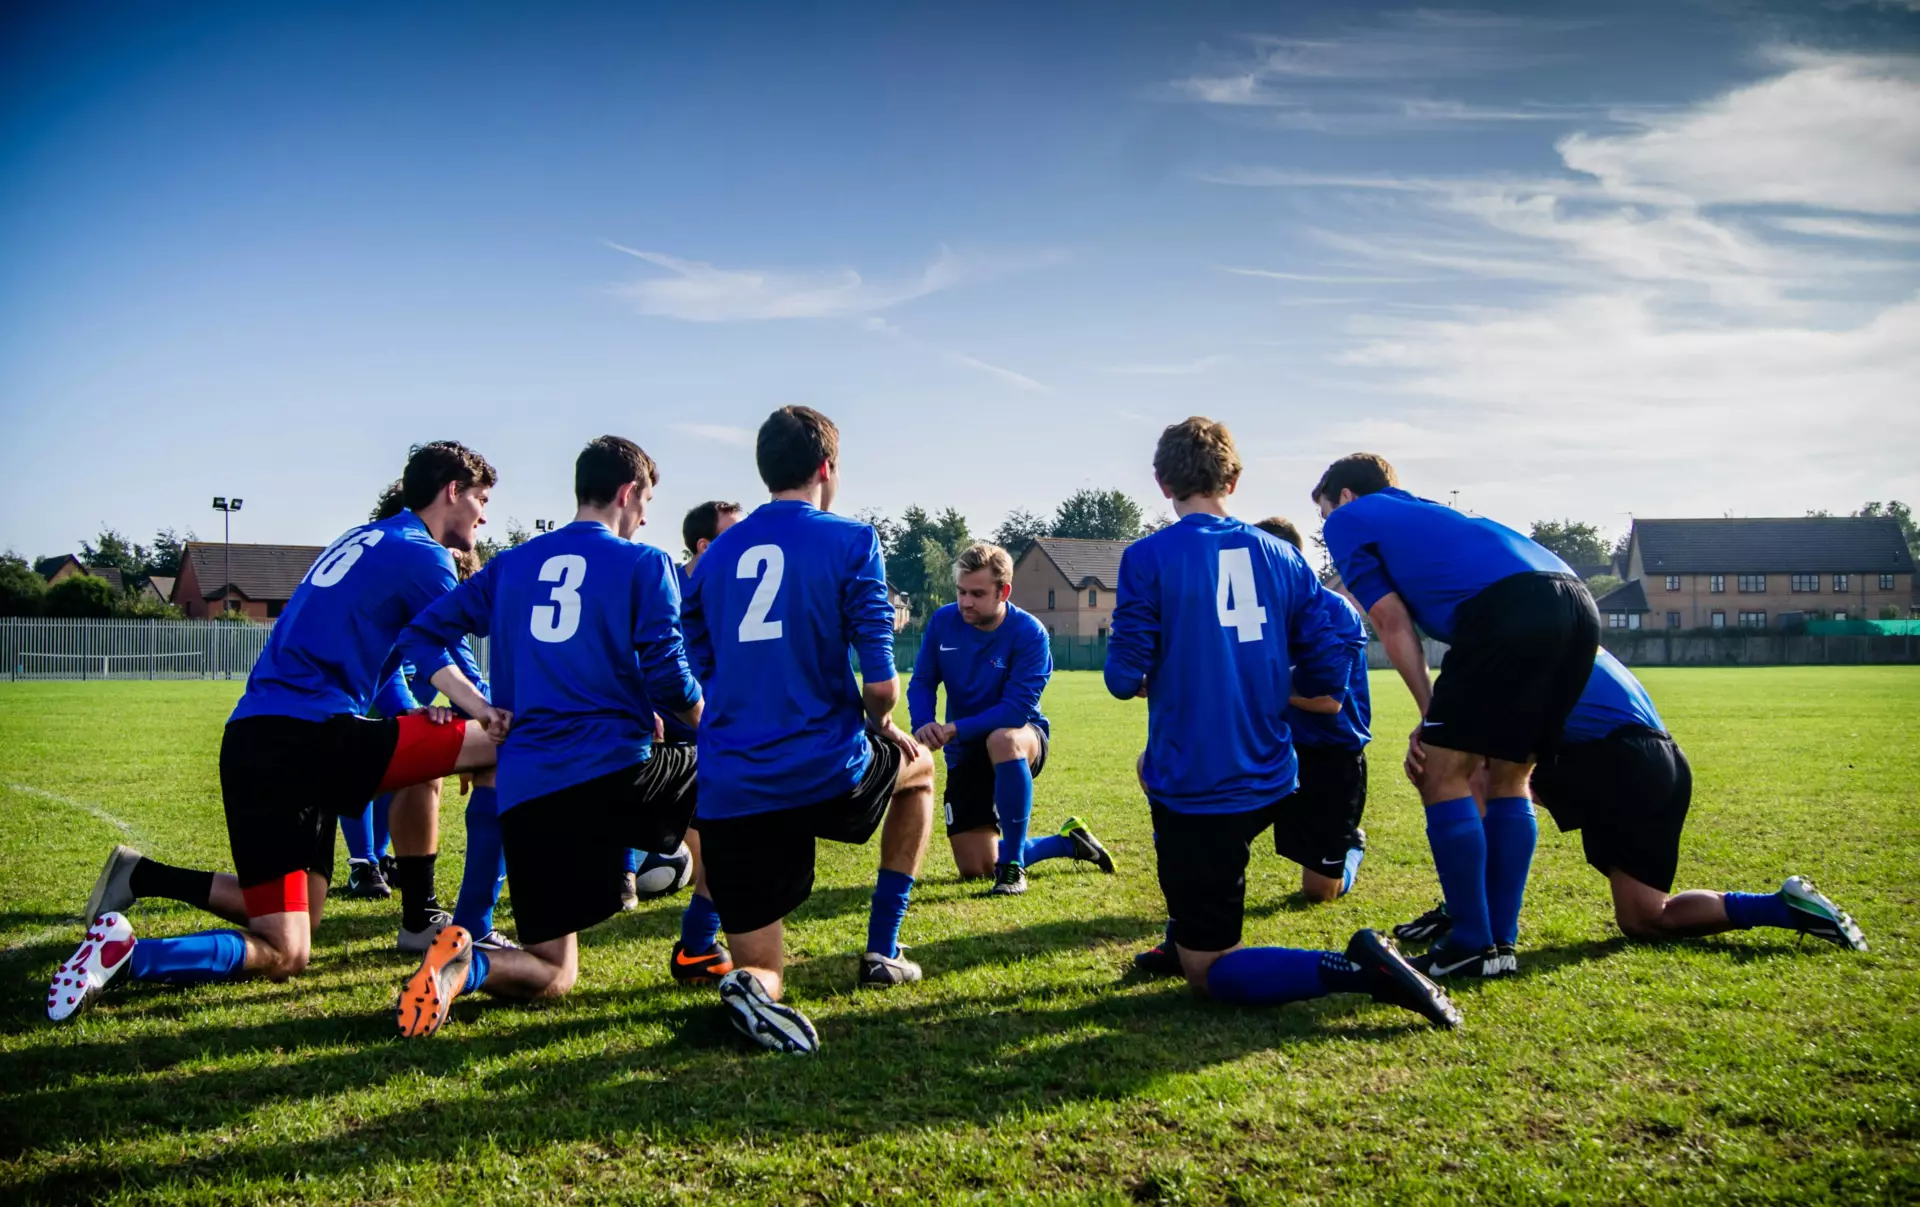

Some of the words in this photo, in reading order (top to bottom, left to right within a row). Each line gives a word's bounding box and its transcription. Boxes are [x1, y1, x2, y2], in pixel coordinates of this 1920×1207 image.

[530, 554, 587, 643] 3
[736, 544, 786, 642] 2
[1216, 547, 1268, 643] 4
